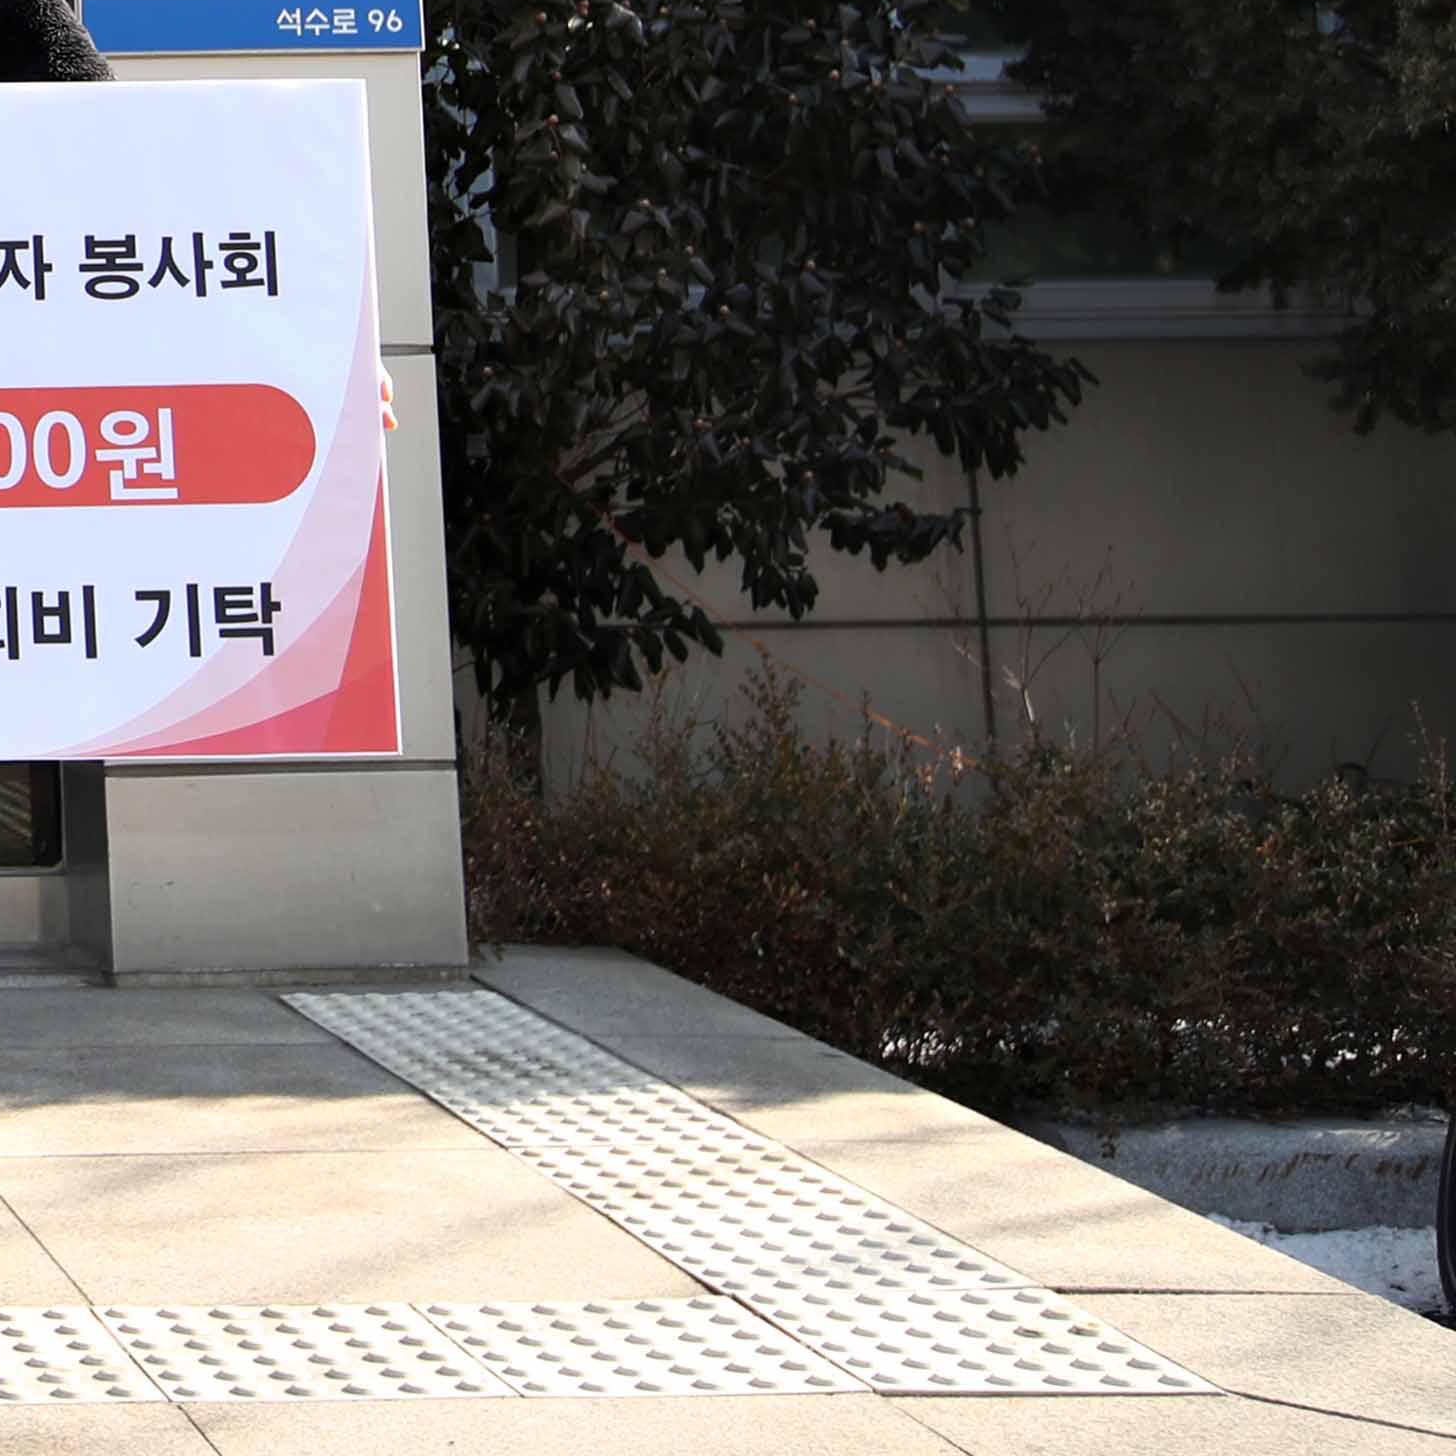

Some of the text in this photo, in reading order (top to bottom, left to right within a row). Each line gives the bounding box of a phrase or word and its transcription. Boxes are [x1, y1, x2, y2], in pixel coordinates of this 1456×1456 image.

[276, 7, 403, 37] 석수로 96
[77, 229, 280, 298] 봉사회
[134, 580, 281, 657] 기탁
